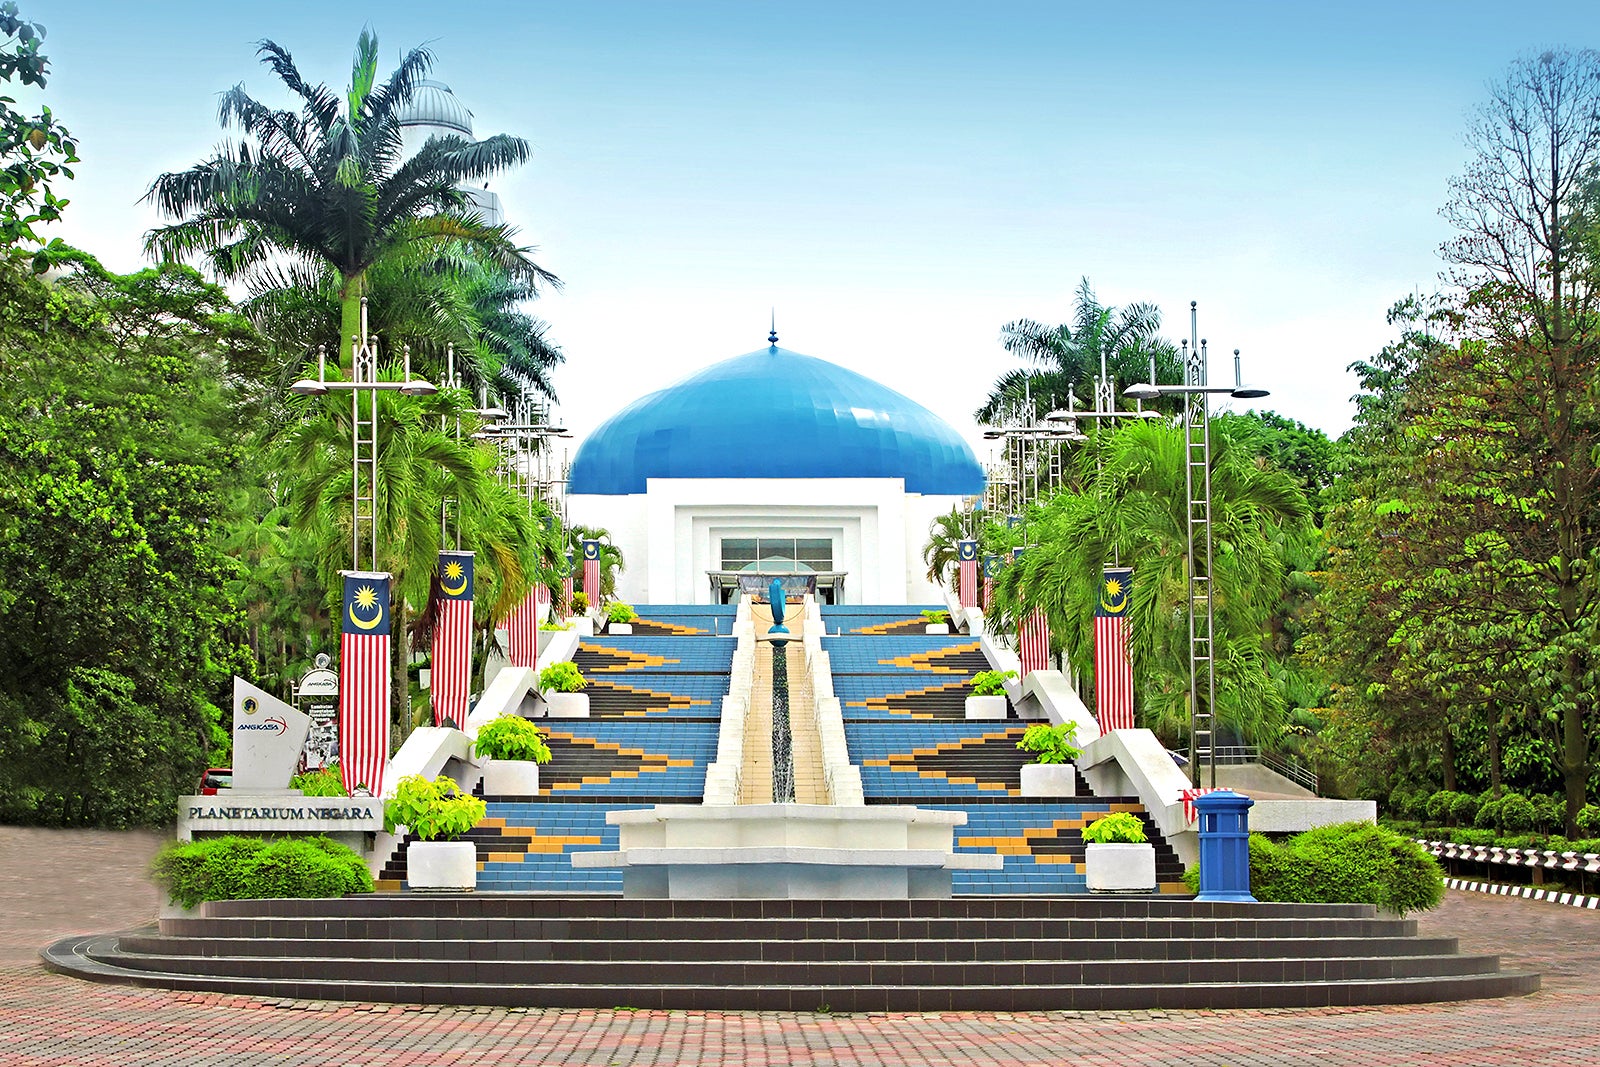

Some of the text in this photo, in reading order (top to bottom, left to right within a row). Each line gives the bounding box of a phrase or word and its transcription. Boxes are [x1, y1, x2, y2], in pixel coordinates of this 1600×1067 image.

[237, 723, 279, 731] ANGKASA
[188, 807, 374, 820] PLANETARIUM NEGARA
